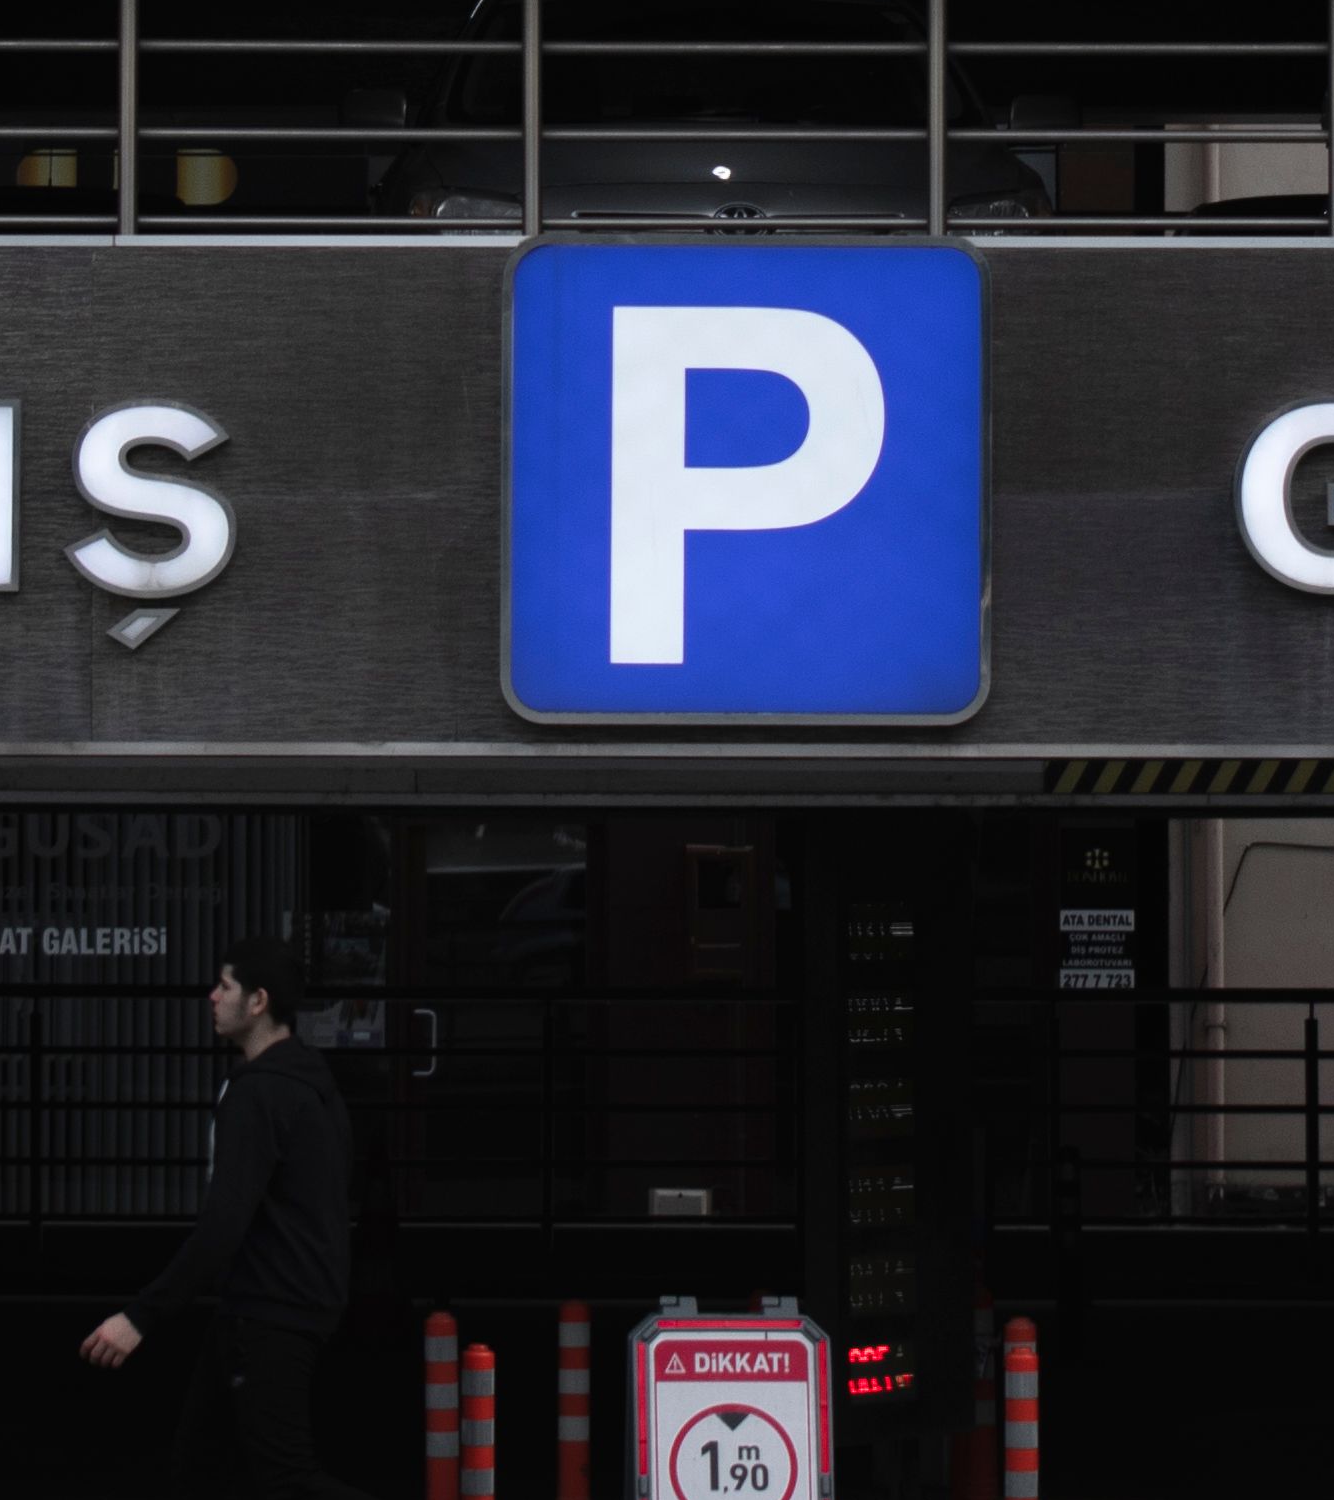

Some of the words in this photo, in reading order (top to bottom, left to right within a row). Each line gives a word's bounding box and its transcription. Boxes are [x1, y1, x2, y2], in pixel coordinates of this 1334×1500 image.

[610, 306, 885, 665] P
[1062, 915, 1084, 926] ATA
[1088, 915, 1132, 926] DENTAL
[1063, 974, 1089, 989] 277
[1093, 974, 1102, 989] 7
[1106, 974, 1132, 989] 723
